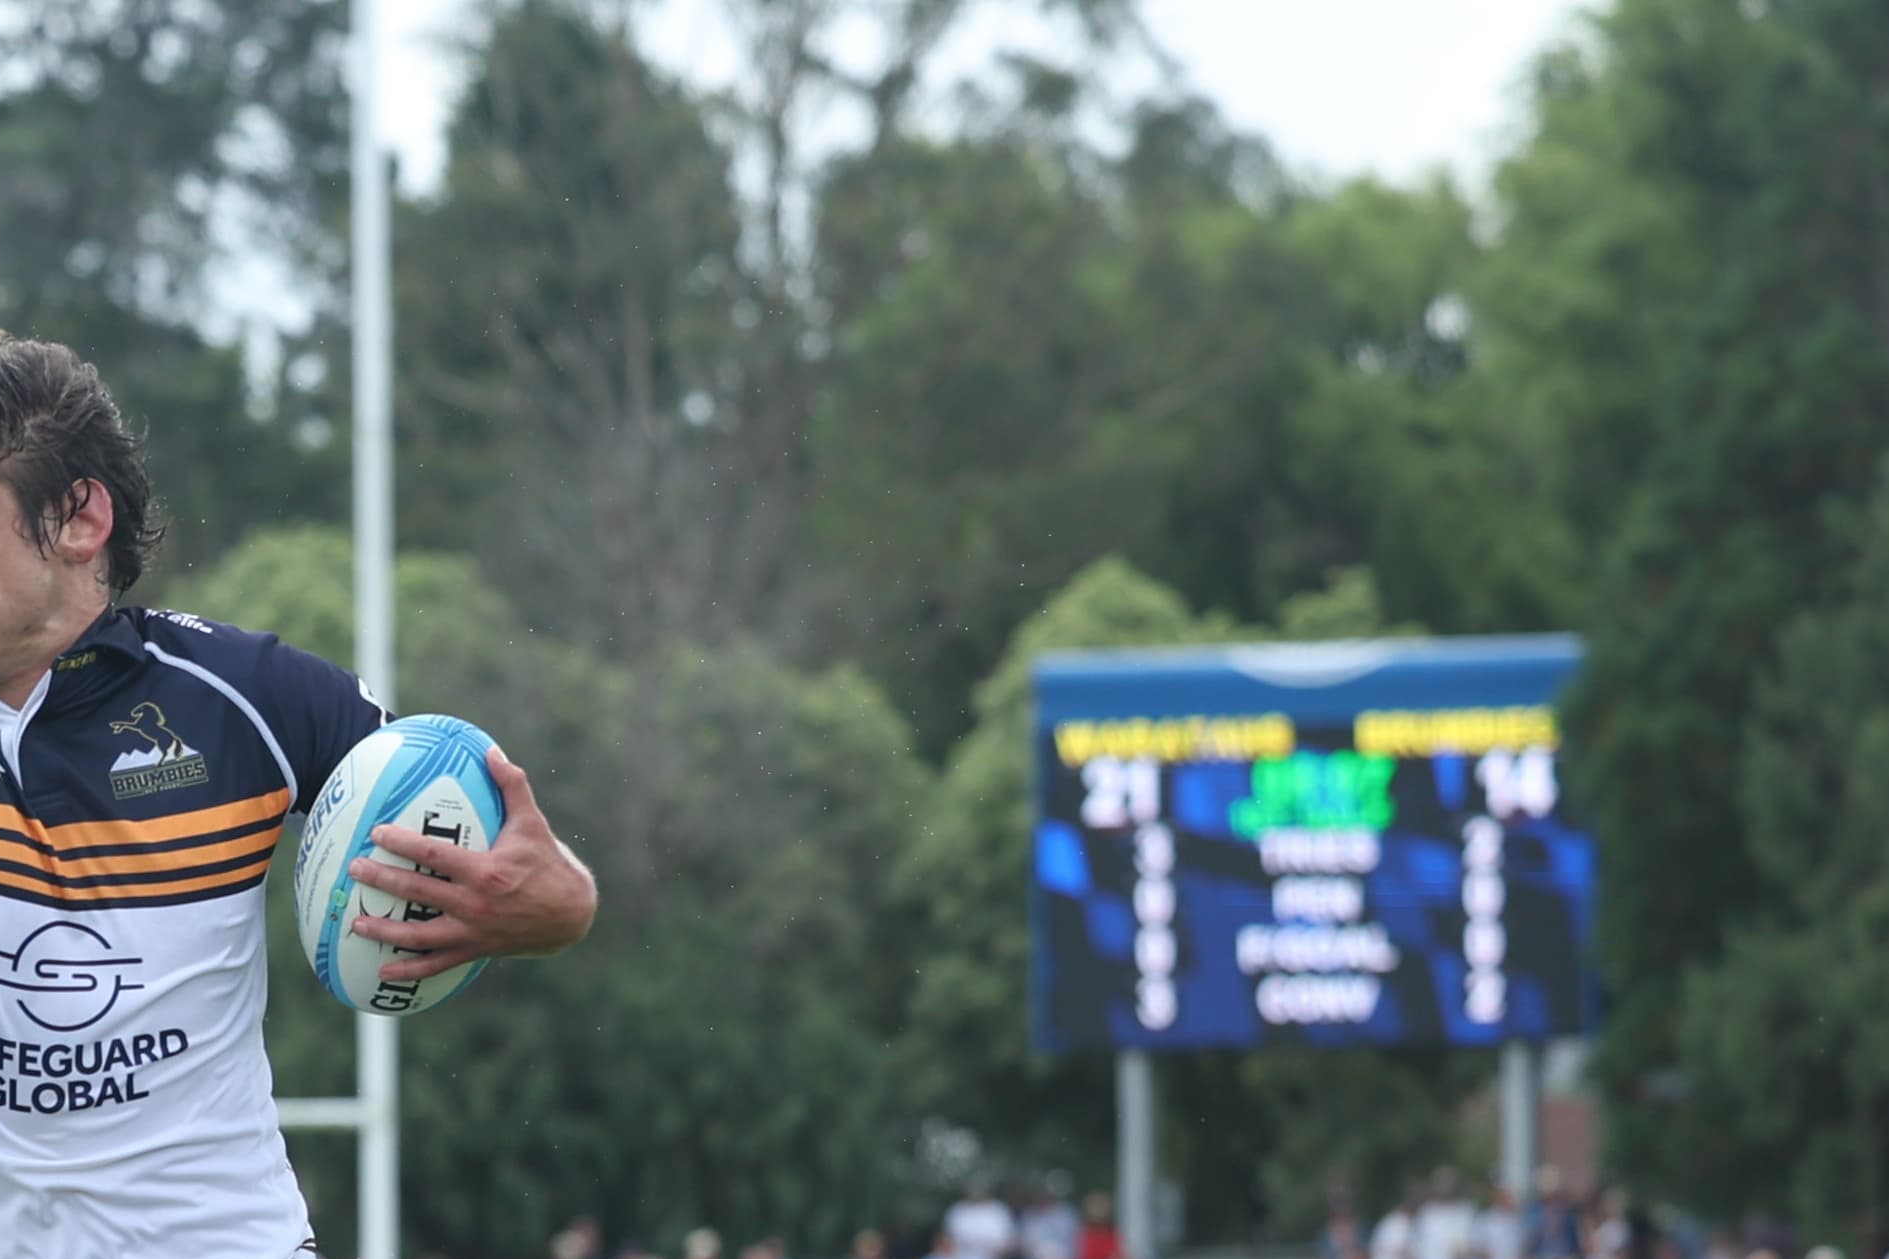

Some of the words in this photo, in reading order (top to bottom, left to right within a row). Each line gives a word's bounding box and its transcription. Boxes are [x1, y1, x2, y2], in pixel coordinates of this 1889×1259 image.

[112, 761, 205, 793] BRUMBIES
[1081, 754, 1161, 828] 21
[295, 777, 345, 890] PACIFIC
